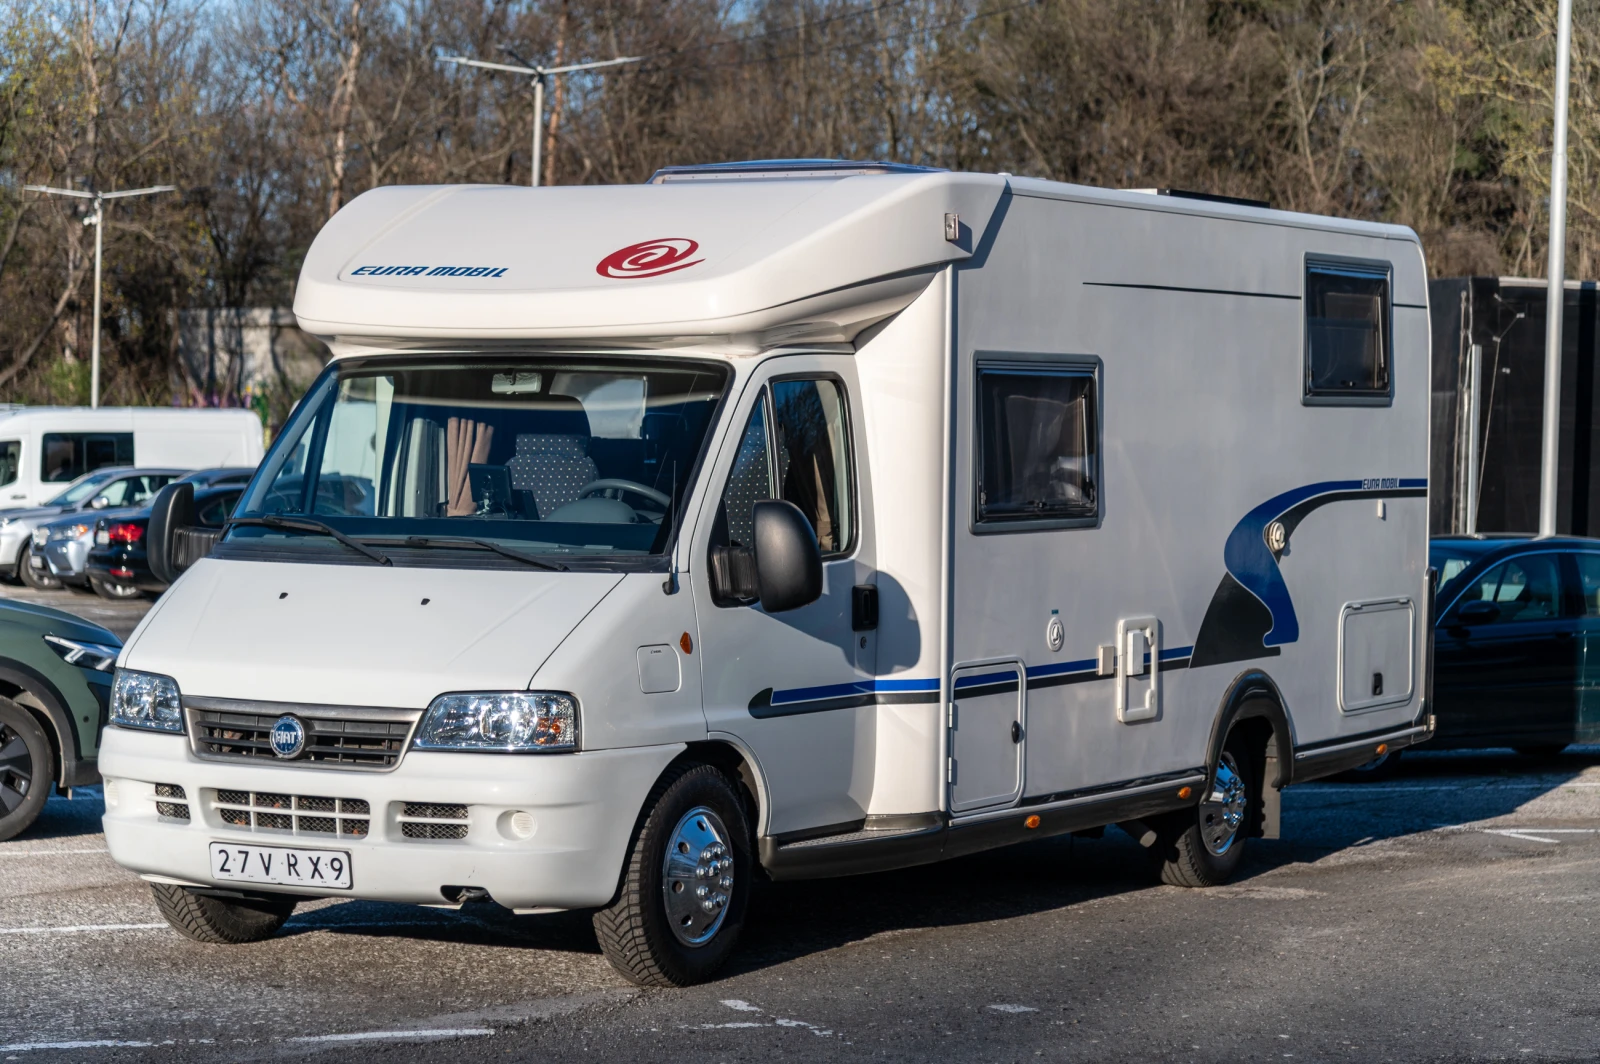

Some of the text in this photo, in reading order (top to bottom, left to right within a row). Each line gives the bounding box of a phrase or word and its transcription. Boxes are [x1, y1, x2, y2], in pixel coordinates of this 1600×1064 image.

[351, 265, 509, 278] EURA MOBIL
[1363, 477, 1399, 490] EURA MOBIL
[275, 730, 297, 744] FIAT
